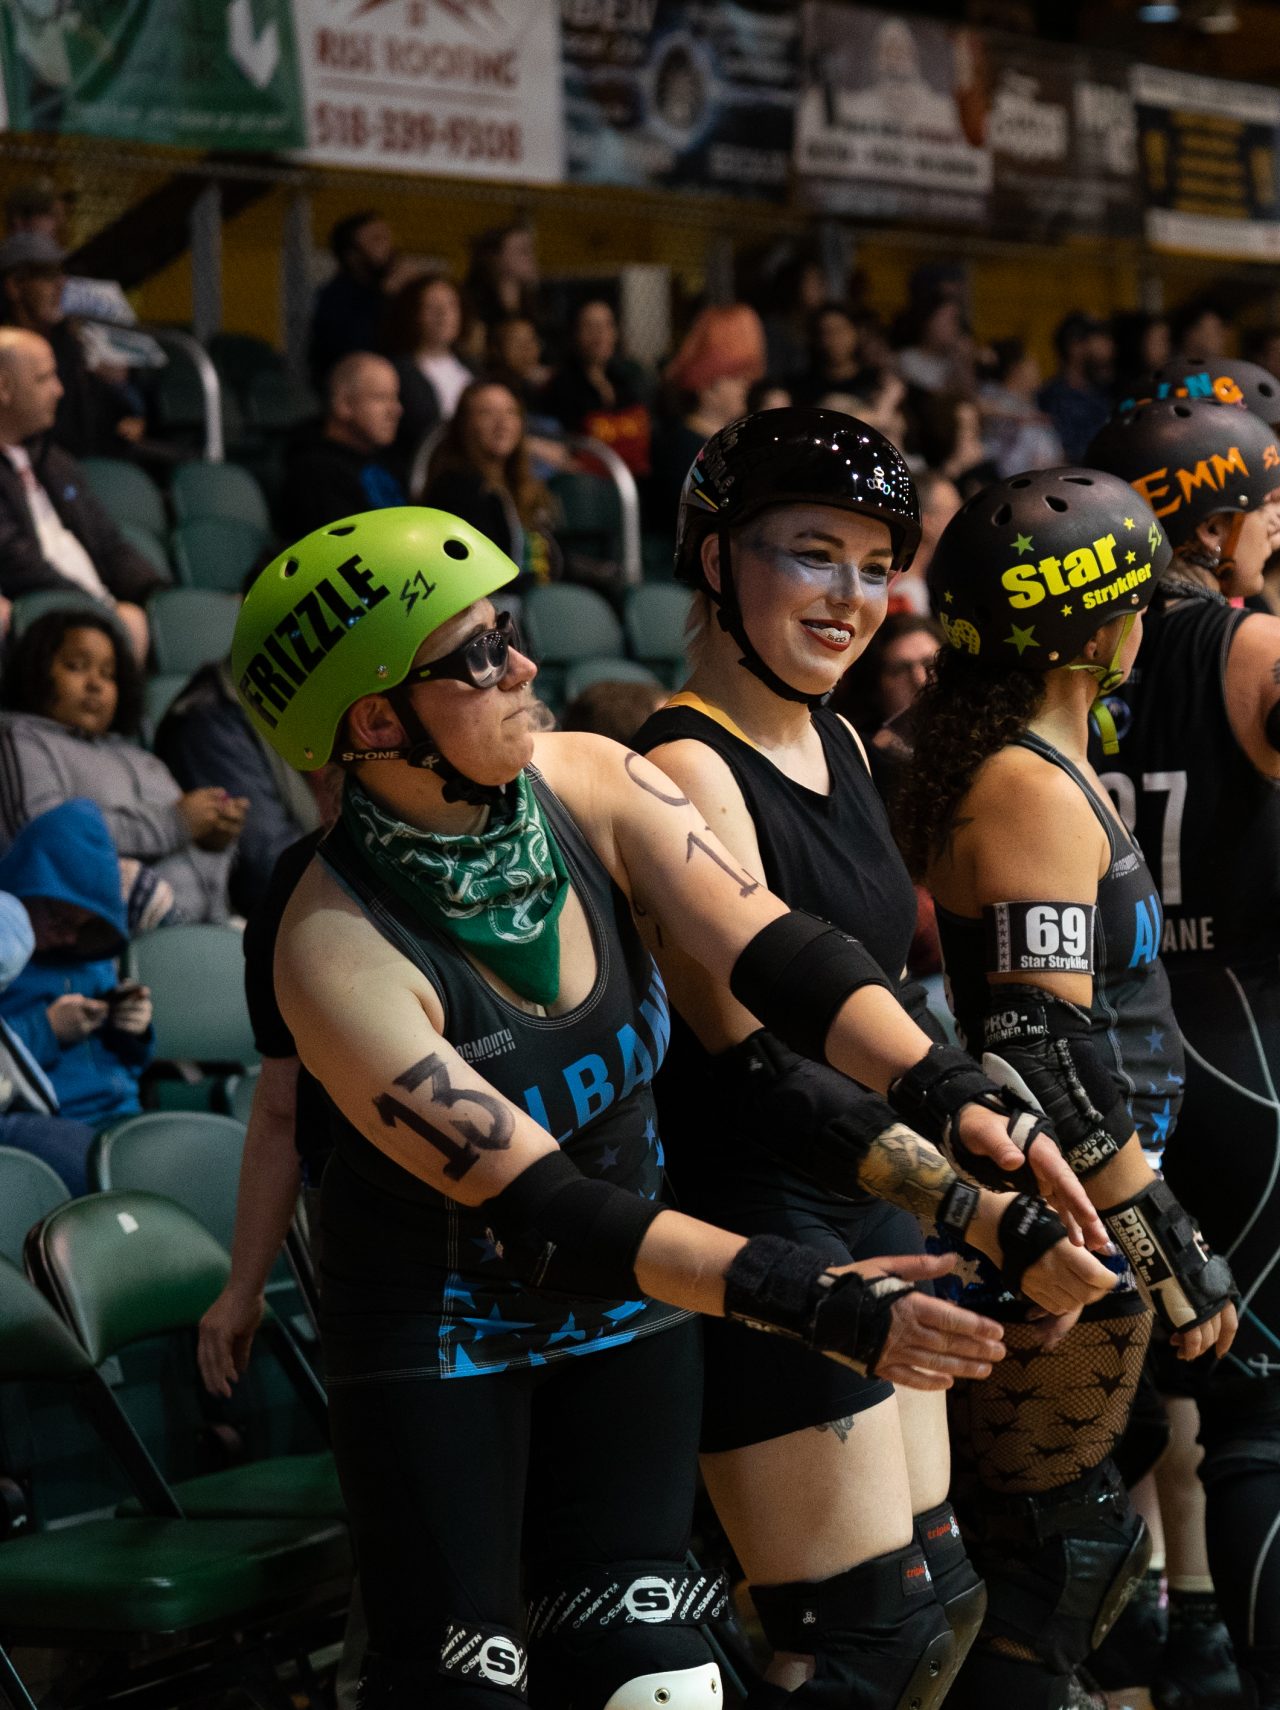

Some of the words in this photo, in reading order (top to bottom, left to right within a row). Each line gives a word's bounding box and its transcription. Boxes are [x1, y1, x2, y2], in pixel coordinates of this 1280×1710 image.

[1130, 447, 1249, 518] EMM
[1001, 533, 1117, 609] Star
[1082, 563, 1152, 610] StrykHer
[238, 554, 391, 730] FRIZZLE
[1026, 905, 1087, 957] 69
[1020, 954, 1047, 969] Star
[1048, 954, 1088, 970] StrykHer
[371, 1052, 516, 1182] 13
[1118, 1207, 1155, 1266] PRO-
[451, 1632, 483, 1665] SMITH
